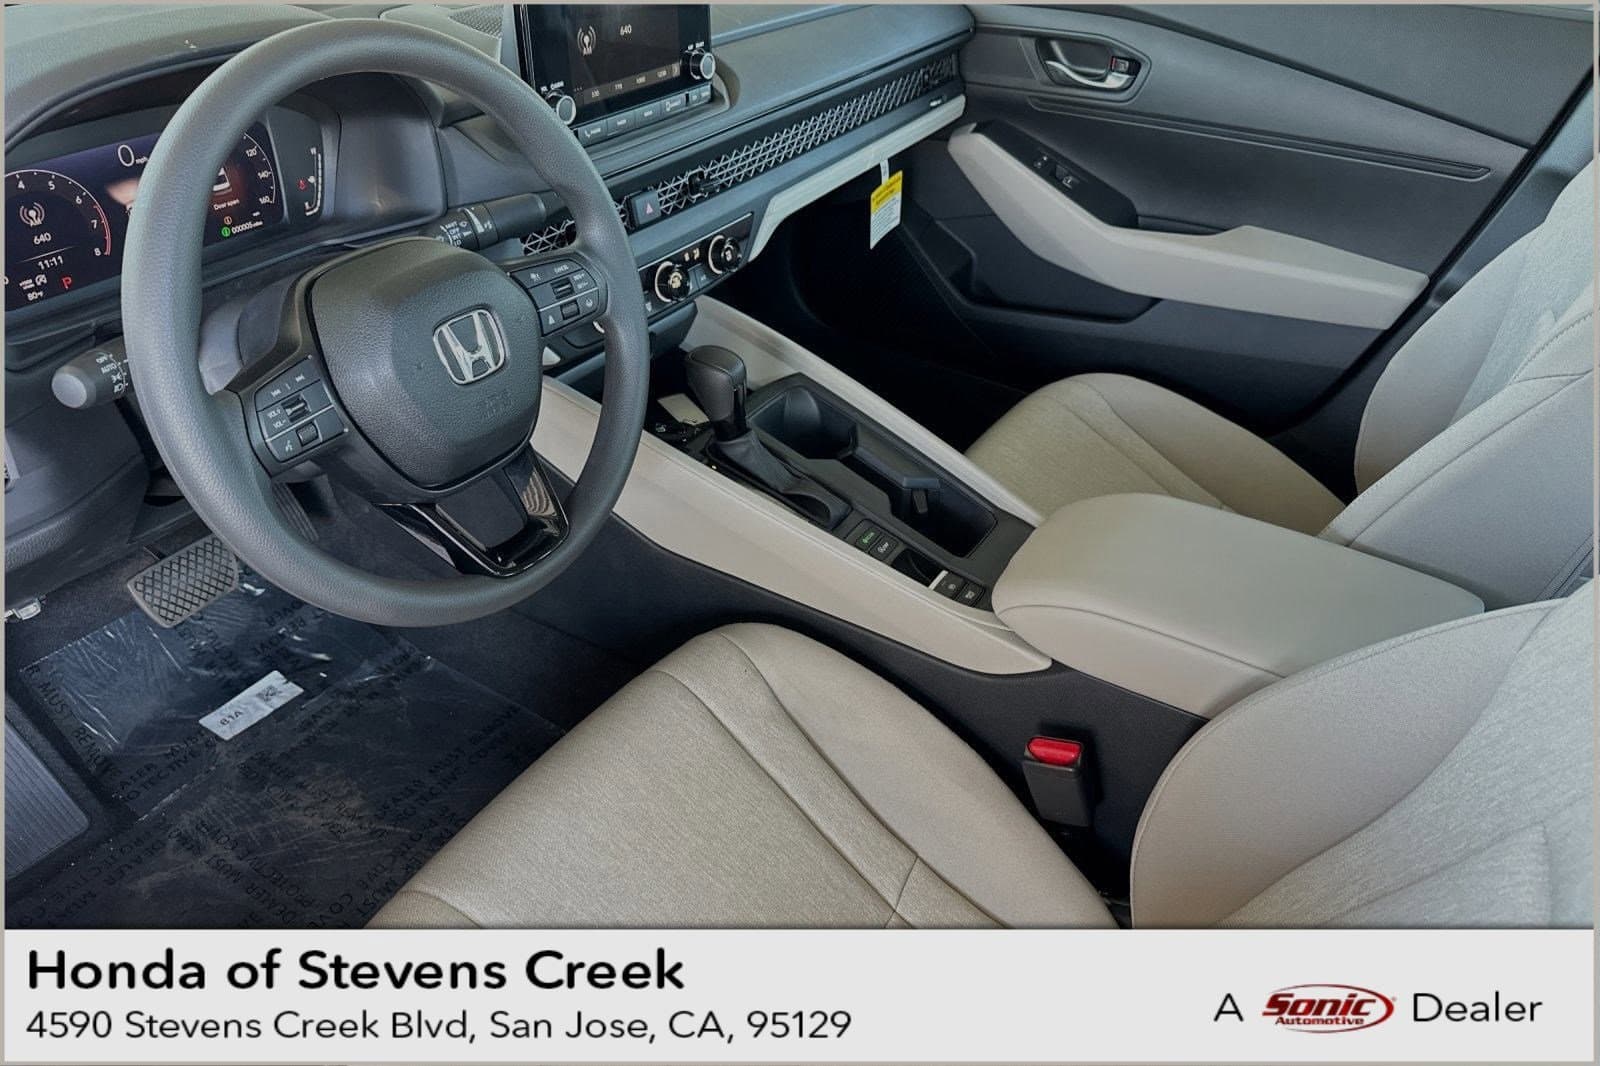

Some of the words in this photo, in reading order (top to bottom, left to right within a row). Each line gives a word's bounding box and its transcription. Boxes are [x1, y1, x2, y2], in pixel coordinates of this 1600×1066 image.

[118, 145, 134, 167] 0
[17, 180, 25, 190] 4
[48, 180, 56, 190] 5
[76, 195, 83, 204] 6
[91, 219, 98, 229] 7
[33, 231, 52, 246] 640
[94, 247, 101, 257] 8
[38, 255, 65, 270] 11:11
[61, 276, 73, 290] P
